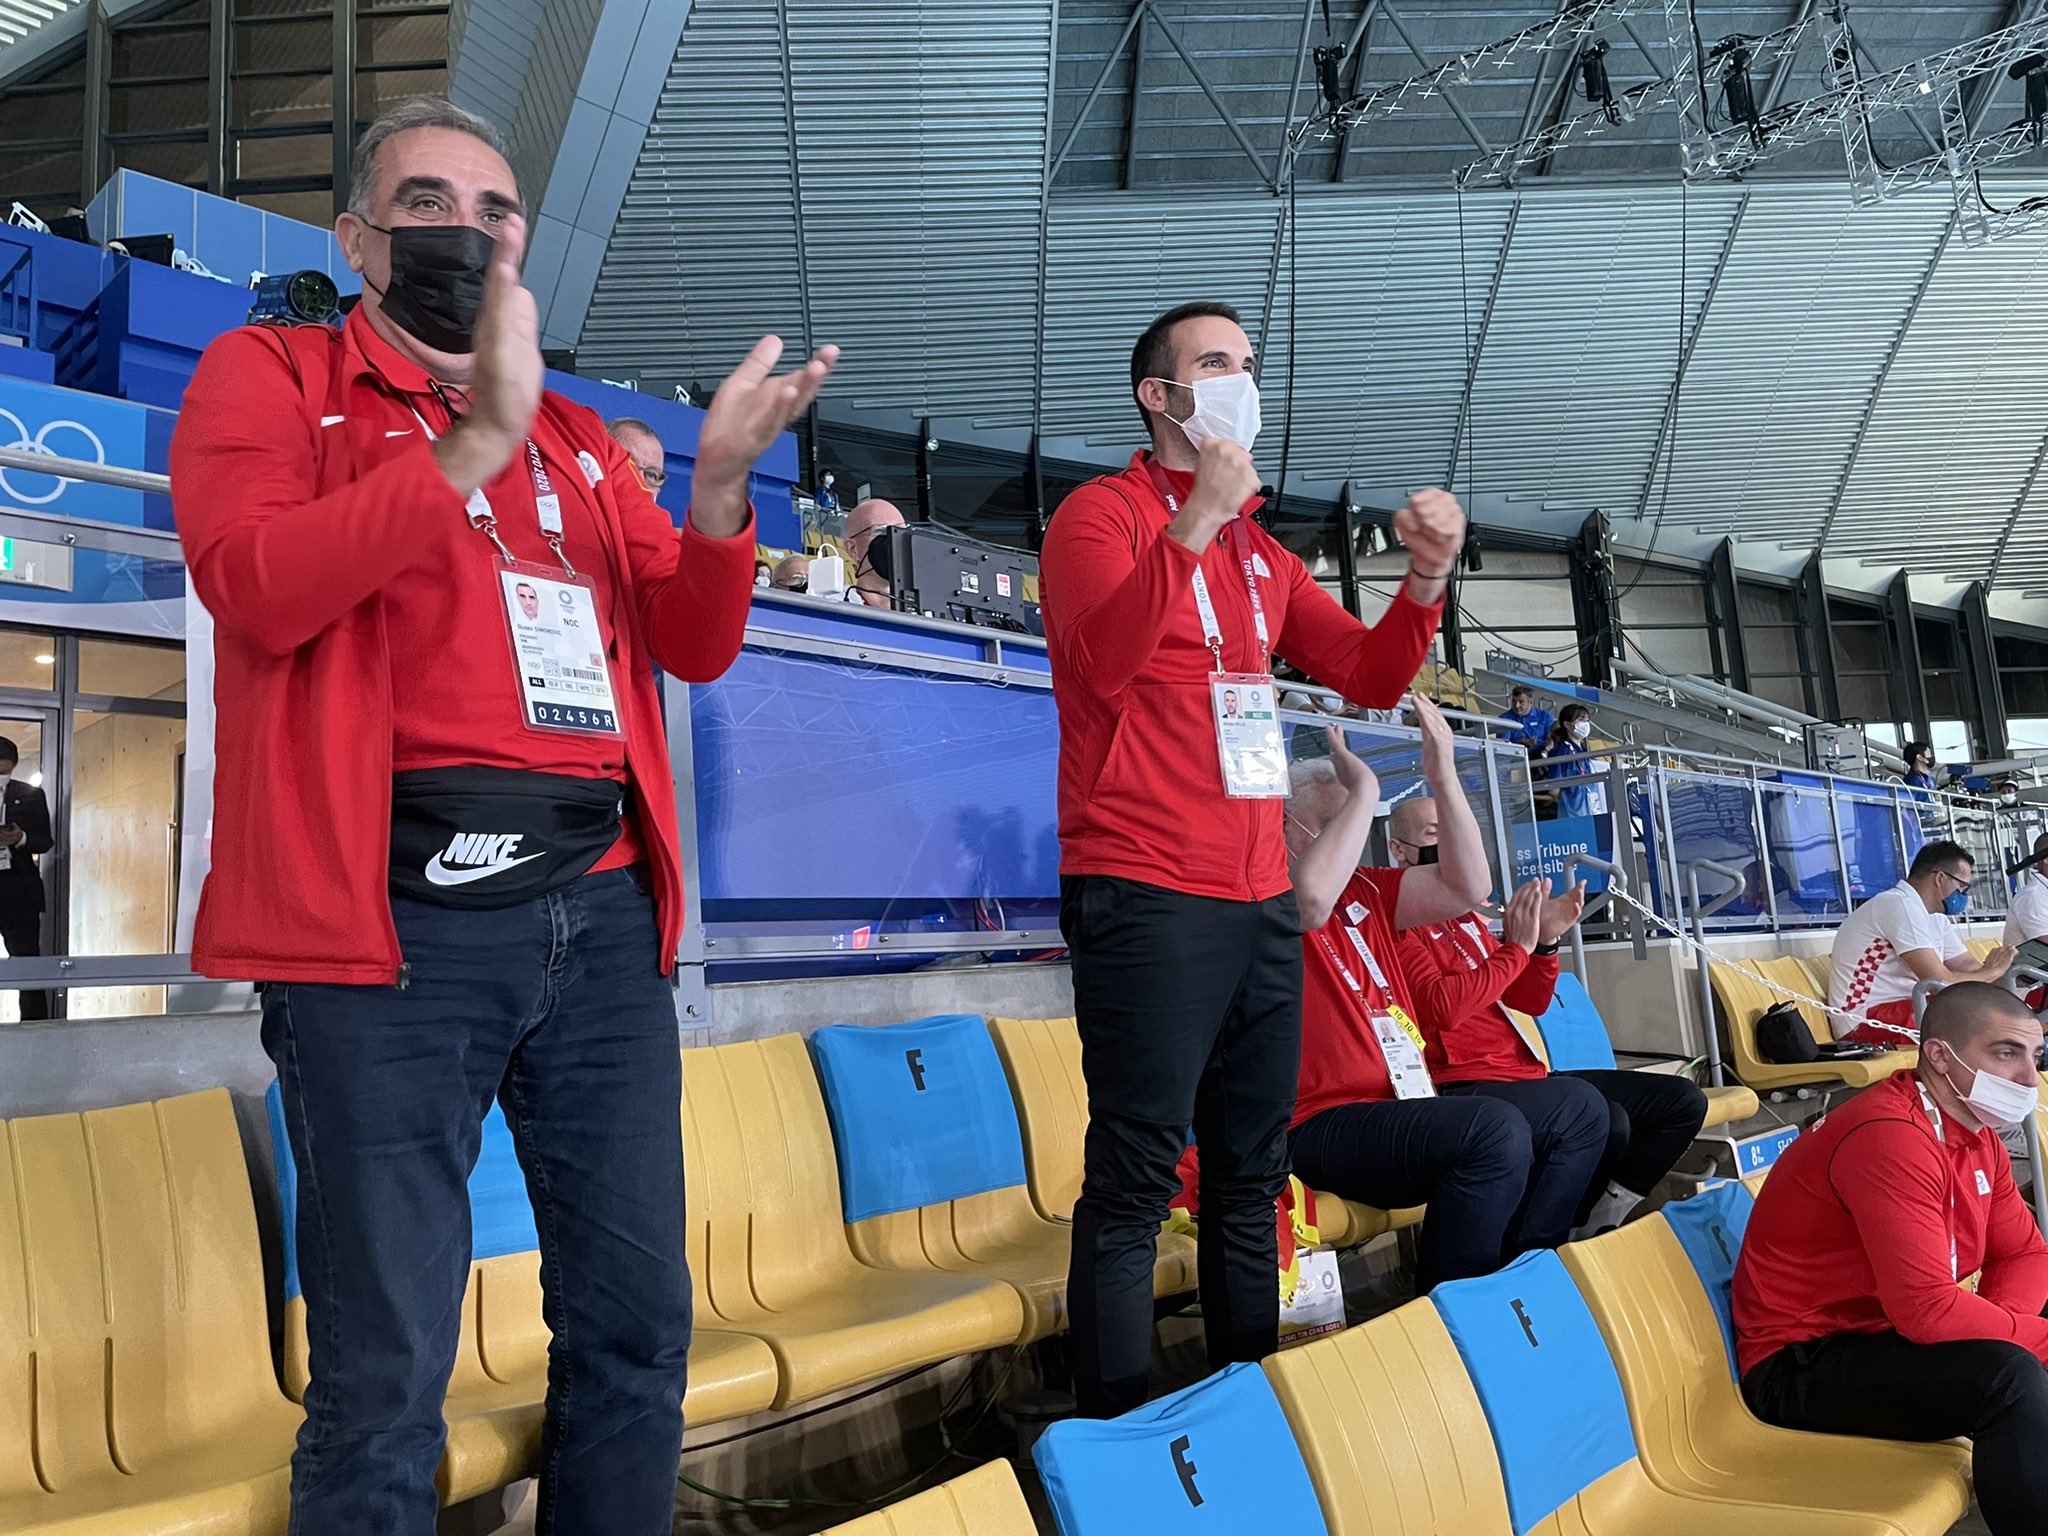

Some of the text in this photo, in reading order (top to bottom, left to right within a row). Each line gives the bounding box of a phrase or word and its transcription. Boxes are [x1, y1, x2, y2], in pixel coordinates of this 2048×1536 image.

[535, 466, 551, 491] 2020
[1243, 559, 1256, 589] TOKYO
[563, 618, 580, 628] NOC
[442, 832, 524, 866] NIKE
[1516, 849, 1531, 860] ss
[1394, 1010, 1403, 1020] 10
[1404, 1022, 1414, 1032] 10
[1414, 1035, 1422, 1044] 10
[906, 1049, 926, 1091] F
[1750, 1145, 1758, 1167] 8
[1711, 1225, 1732, 1265] F
[1510, 1298, 1539, 1348] F
[1170, 1434, 1204, 1508] F
